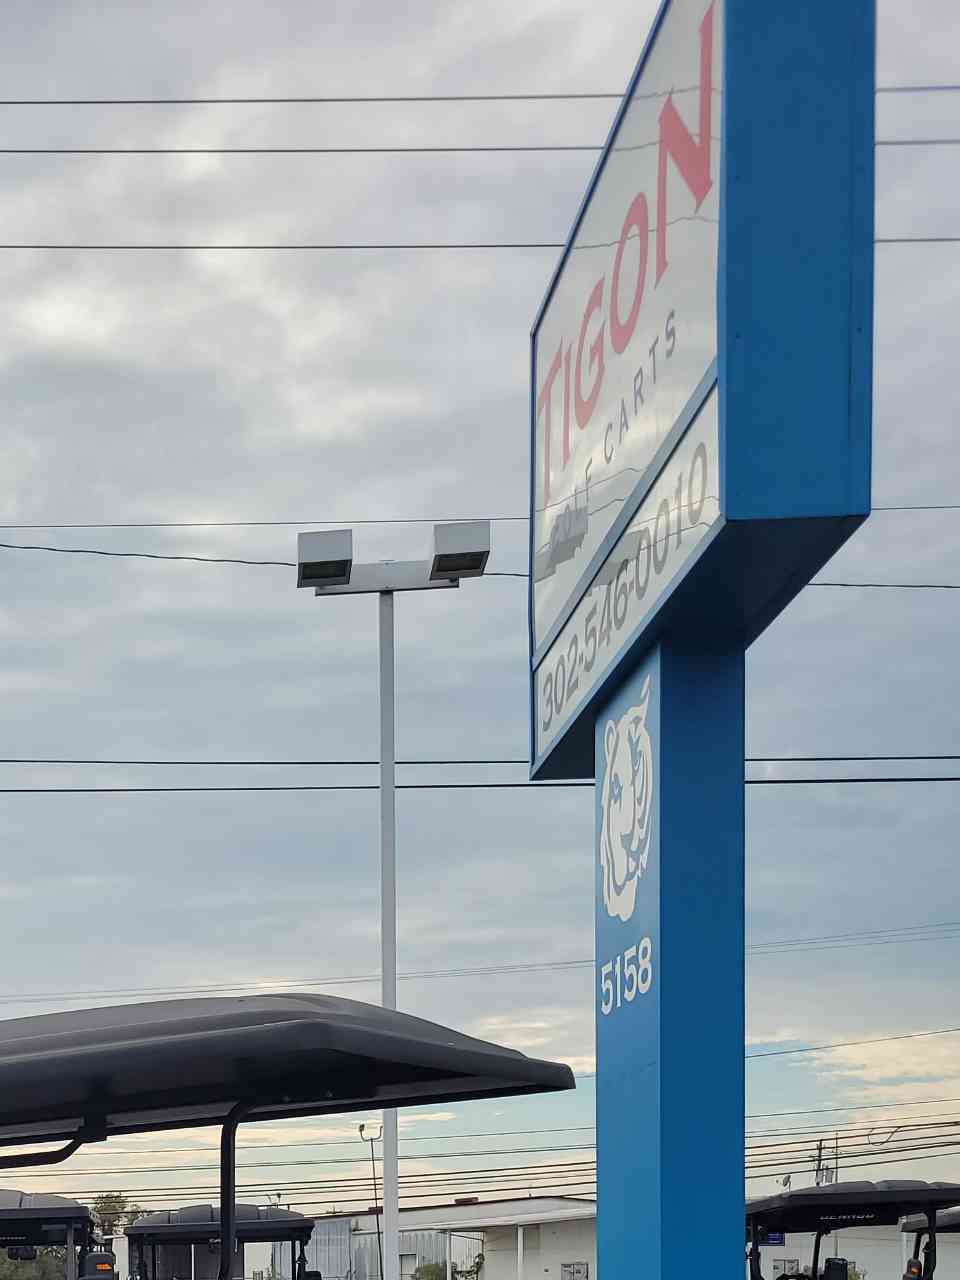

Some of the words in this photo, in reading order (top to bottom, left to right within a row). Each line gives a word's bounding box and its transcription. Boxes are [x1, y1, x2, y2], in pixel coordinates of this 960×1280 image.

[537, 0, 716, 510] TIGON
[602, 309, 676, 464] CARTS
[601, 936, 652, 1016] 5158
